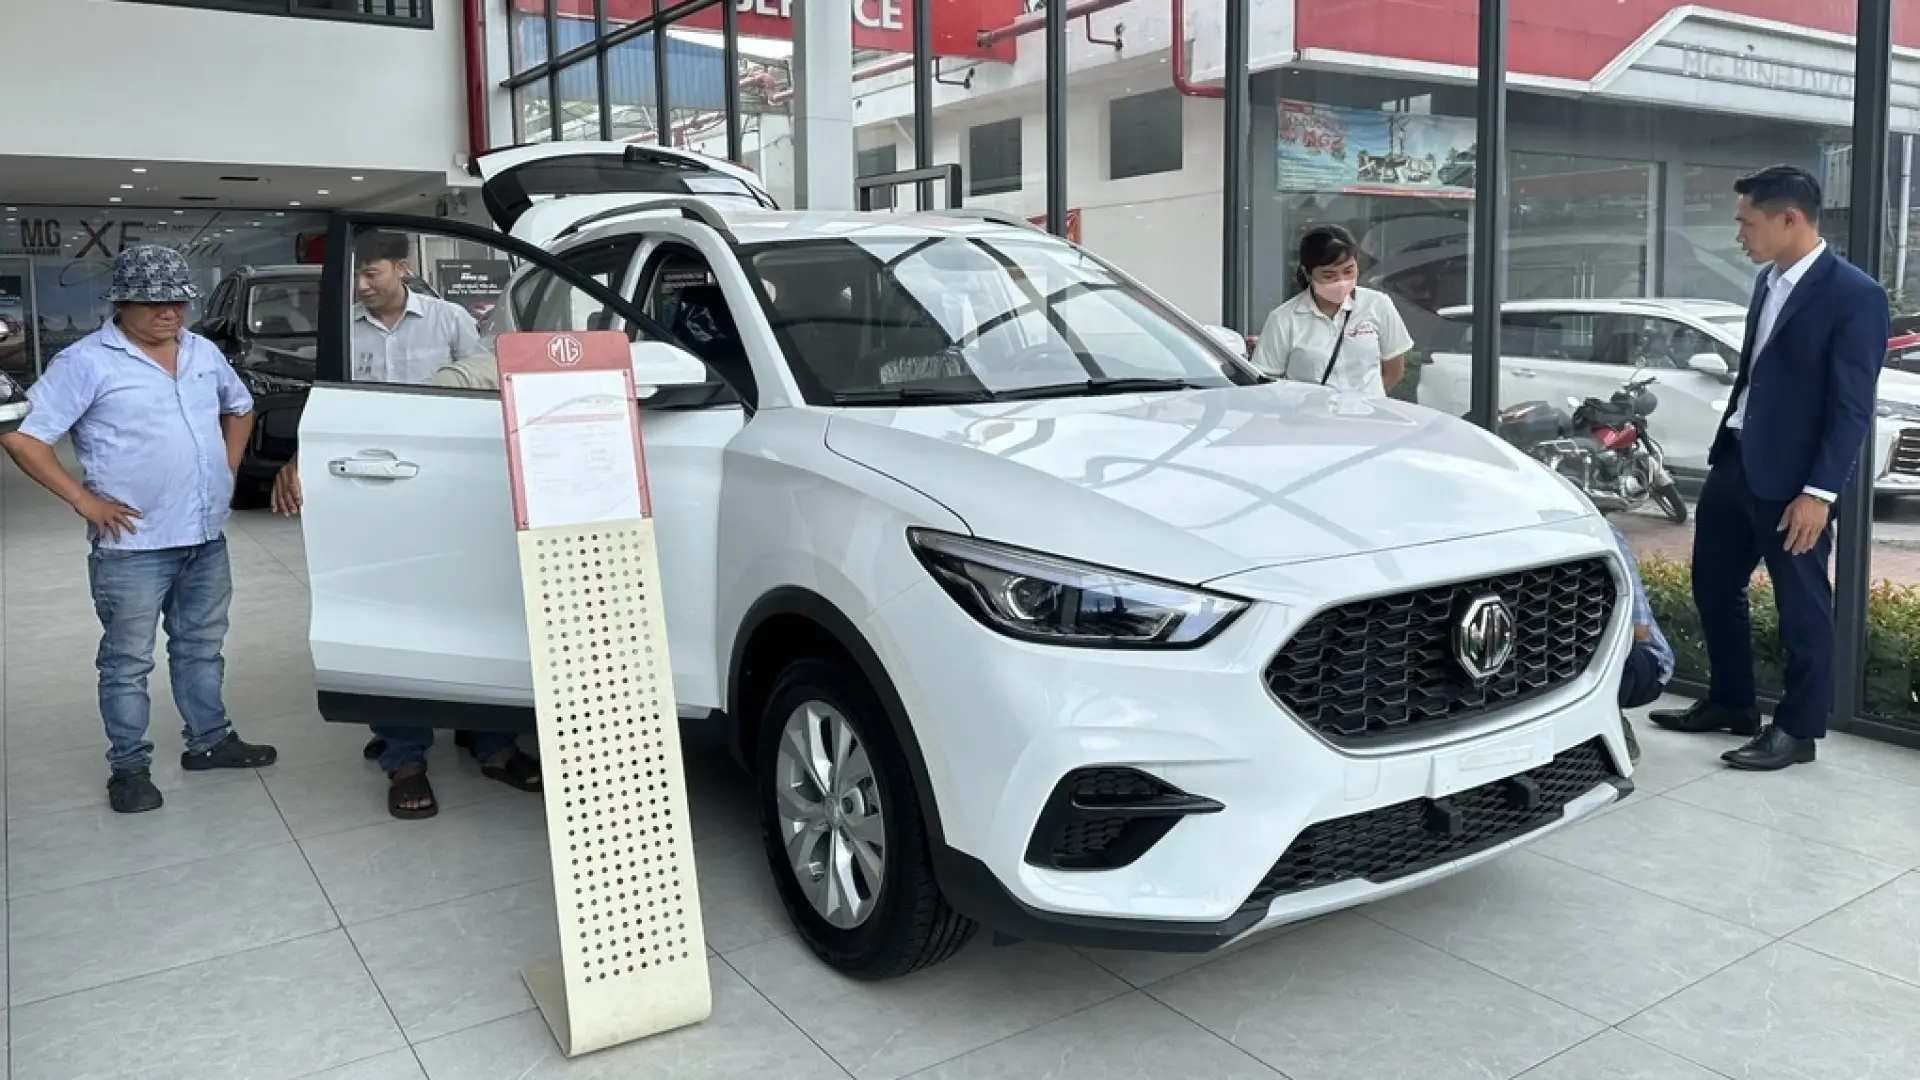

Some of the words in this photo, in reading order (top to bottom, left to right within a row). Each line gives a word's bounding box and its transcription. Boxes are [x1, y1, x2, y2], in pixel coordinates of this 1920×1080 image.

[20, 218, 61, 247] MG
[550, 337, 580, 363] MG
[1468, 604, 1511, 669] MG
